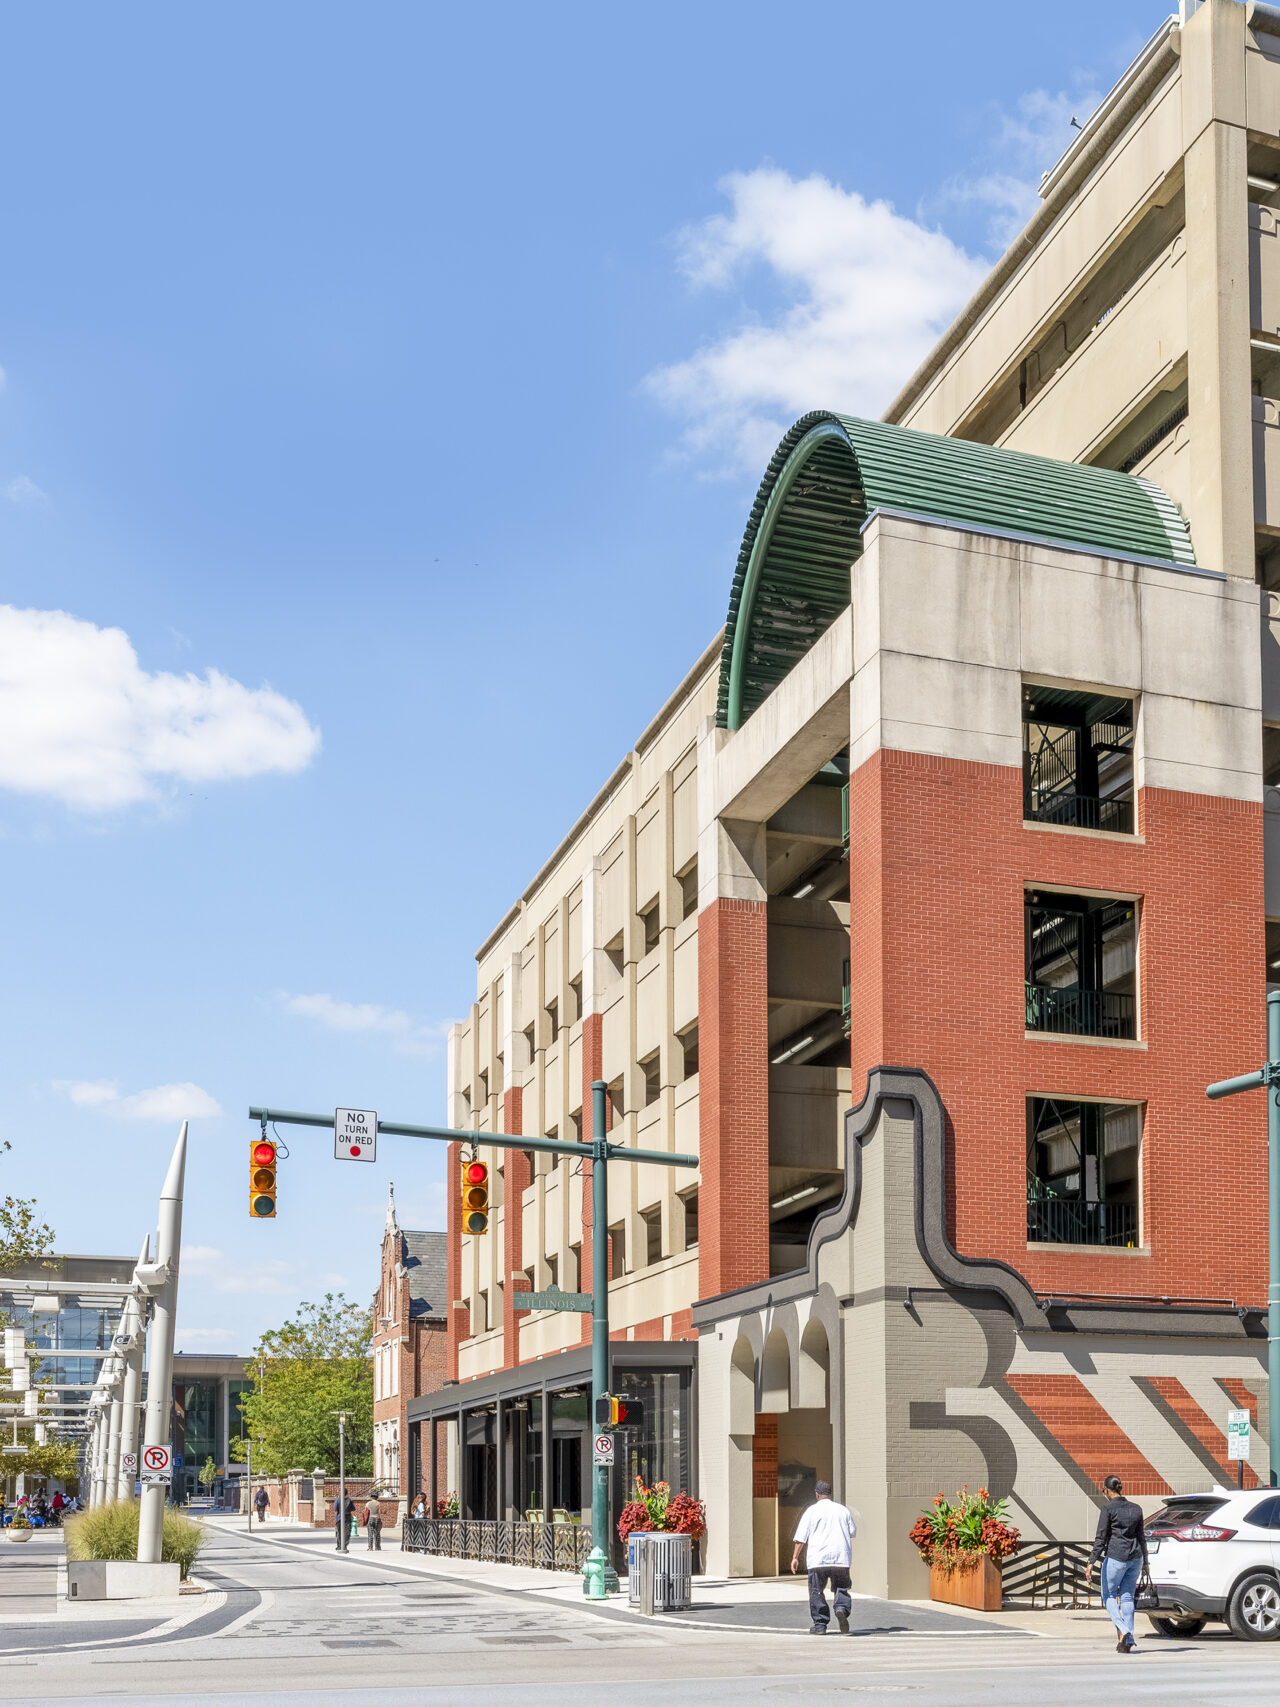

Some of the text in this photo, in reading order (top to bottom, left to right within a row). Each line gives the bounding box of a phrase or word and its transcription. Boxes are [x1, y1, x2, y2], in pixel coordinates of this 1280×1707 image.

[347, 1112, 365, 1124] NO
[344, 1124, 368, 1135] TURN
[338, 1134, 373, 1145] ON RED
[527, 1299, 576, 1309] ILLINOIS
